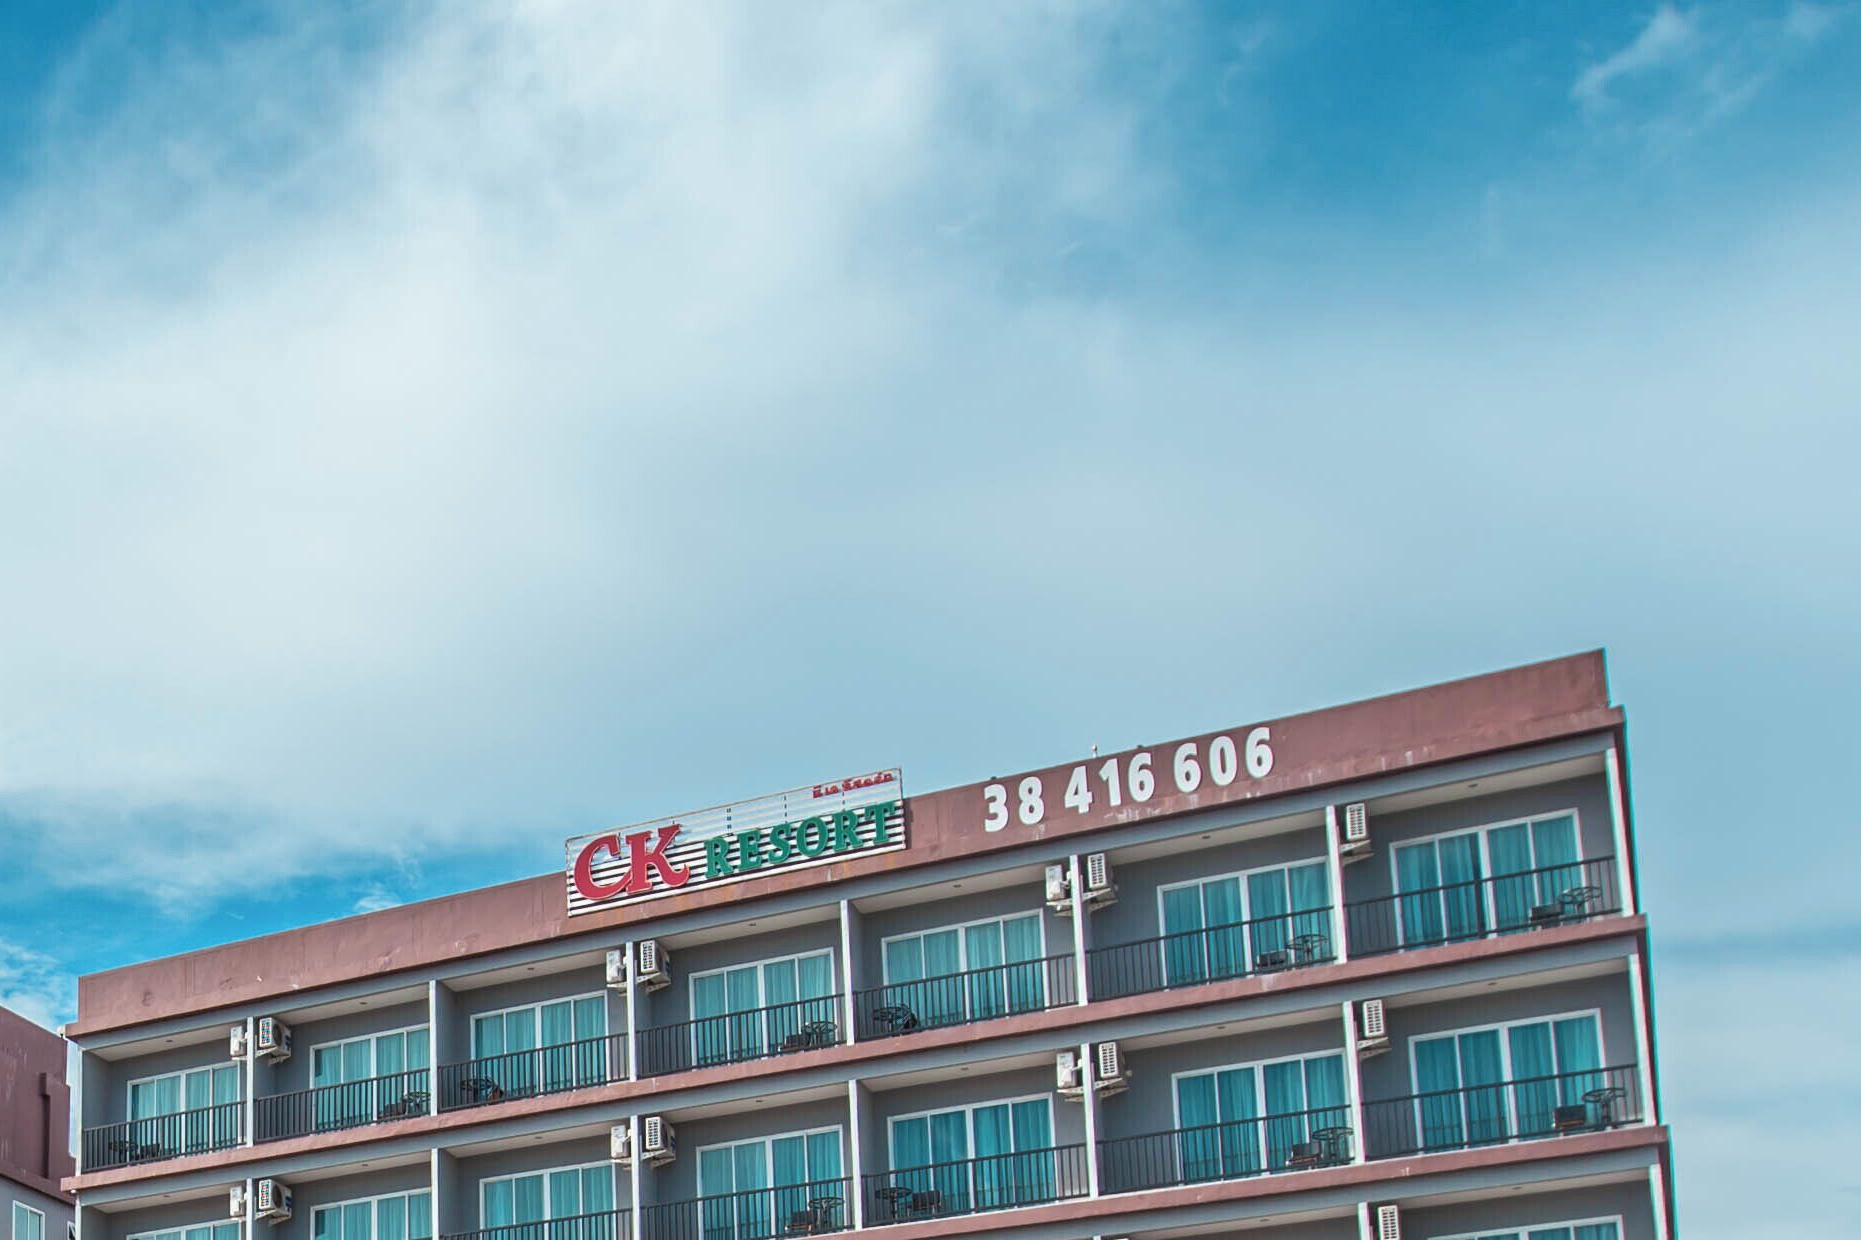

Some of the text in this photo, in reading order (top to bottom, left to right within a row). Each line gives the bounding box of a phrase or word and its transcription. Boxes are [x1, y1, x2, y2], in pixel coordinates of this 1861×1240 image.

[984, 727, 1274, 832] 38 416 606
[574, 801, 897, 900] CK RESORT
